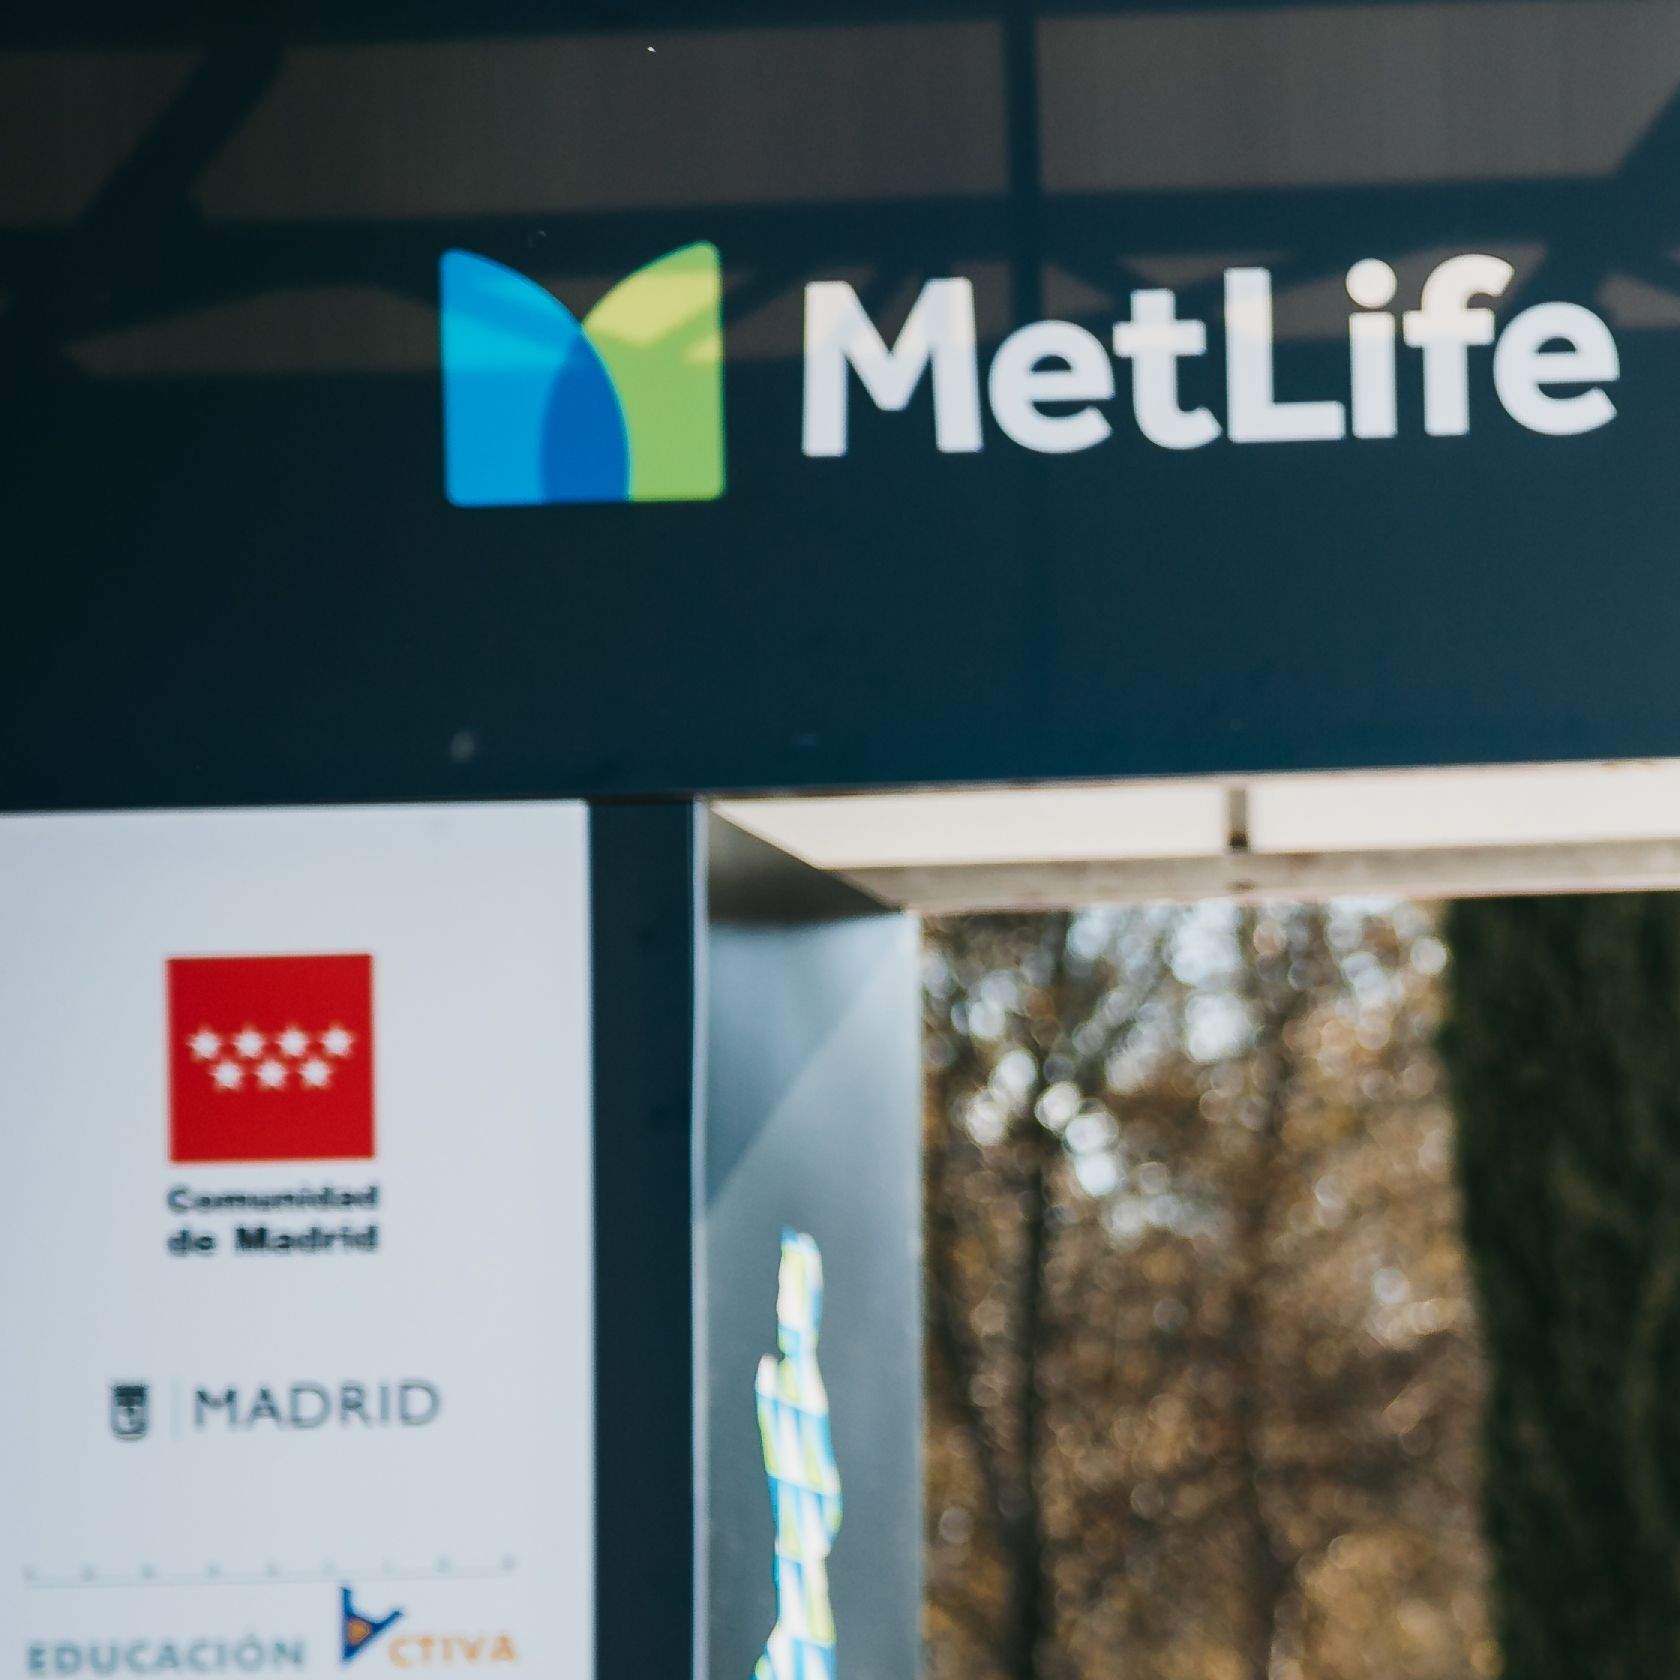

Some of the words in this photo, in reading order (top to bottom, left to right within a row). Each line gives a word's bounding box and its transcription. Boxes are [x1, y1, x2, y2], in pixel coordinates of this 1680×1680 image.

[802, 253, 1620, 457] MetLife
[166, 1184, 380, 1213] Comunidad
[166, 1227, 218, 1257] de
[233, 1223, 380, 1256] Madrid
[193, 1379, 443, 1430] MADRID
[25, 1629, 307, 1678] EDUCACIÓN
